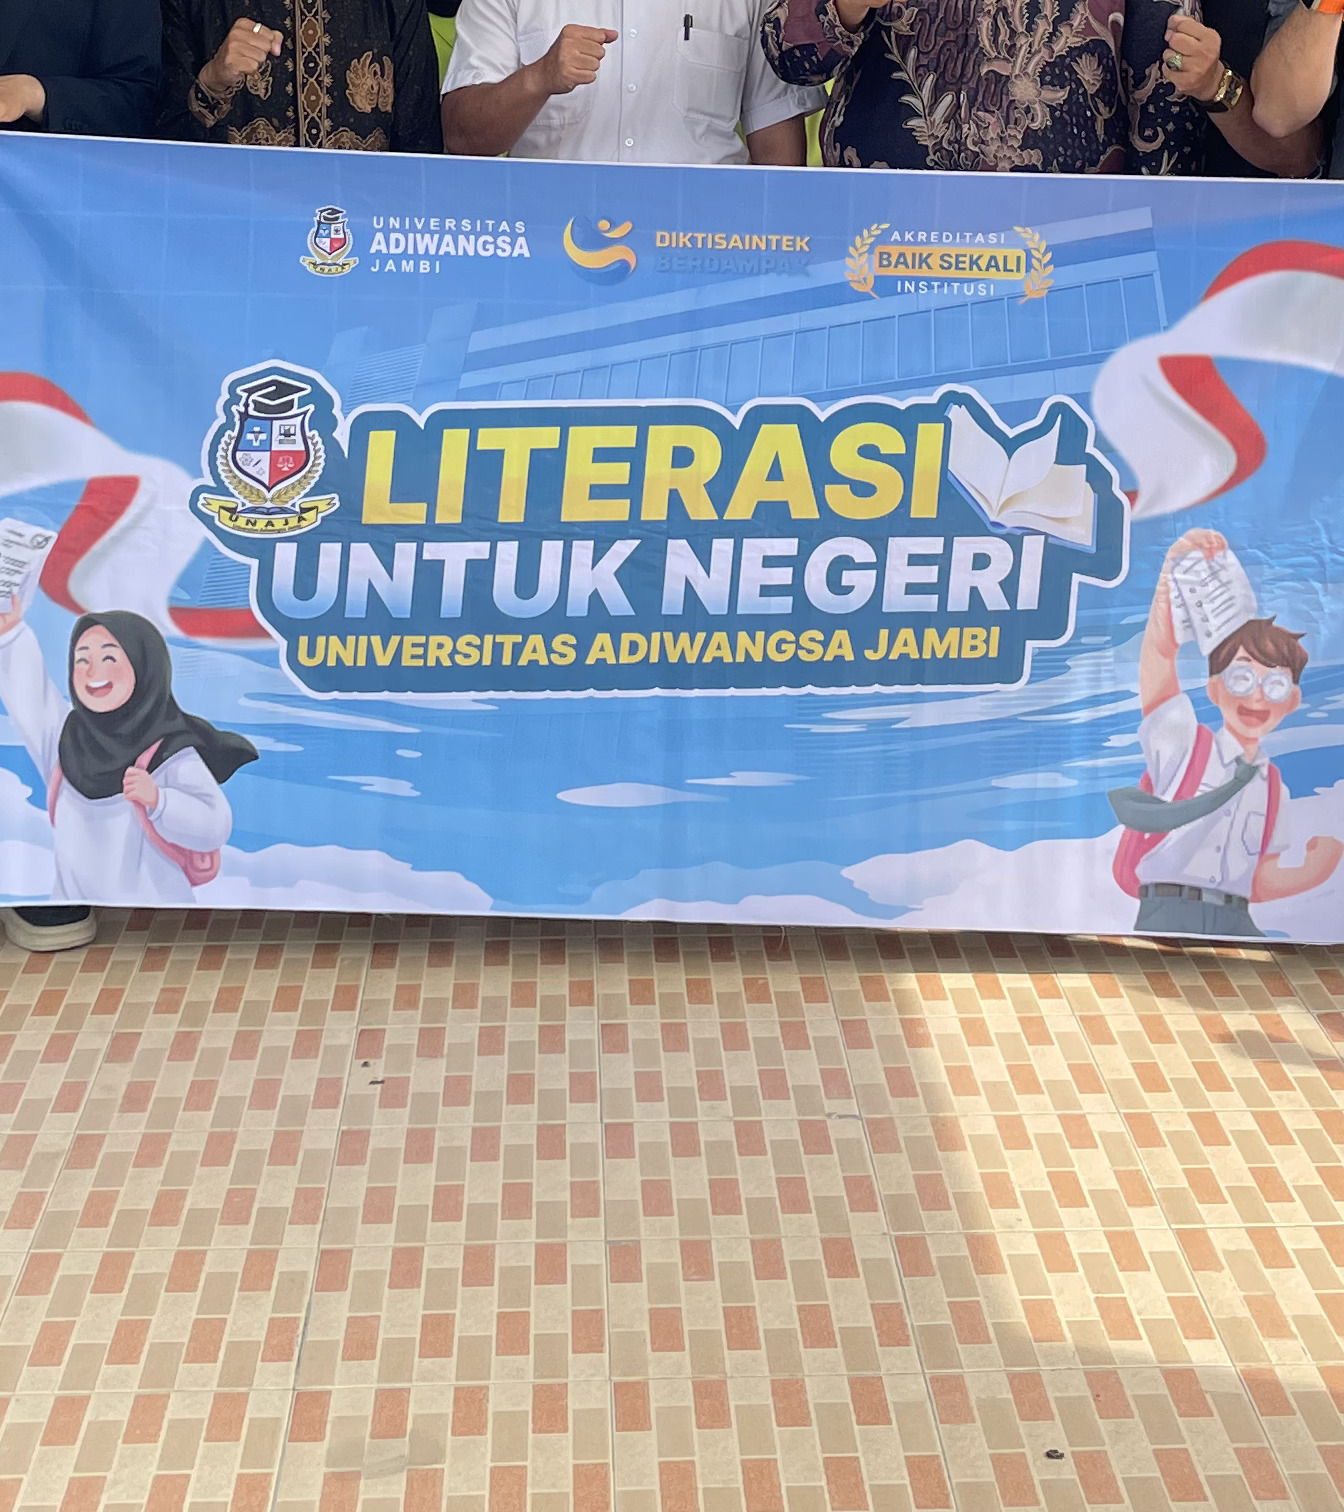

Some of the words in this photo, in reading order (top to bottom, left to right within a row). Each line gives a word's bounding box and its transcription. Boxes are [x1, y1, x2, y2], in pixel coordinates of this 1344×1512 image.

[373, 215, 526, 234] UNIVERSITAS
[369, 231, 531, 258] ADIWANGSA
[656, 231, 810, 252] DIKTISAINTEK
[890, 230, 1005, 244] AKREDITASI
[370, 258, 440, 274] JAMBI
[658, 254, 811, 276] BERDAMPAK
[878, 251, 934, 270] BAIK
[939, 253, 1022, 274] SEKALI
[897, 279, 996, 296] INSTITUSI
[361, 422, 945, 524] LITERASI
[229, 513, 308, 528] UNAJA
[272, 539, 642, 619] UNTUK
[661, 535, 1045, 615] NEGERI
[297, 633, 577, 667] UNIVERSITAS
[585, 629, 855, 665] ADIWANGSA
[864, 626, 1001, 661] JAMBI
